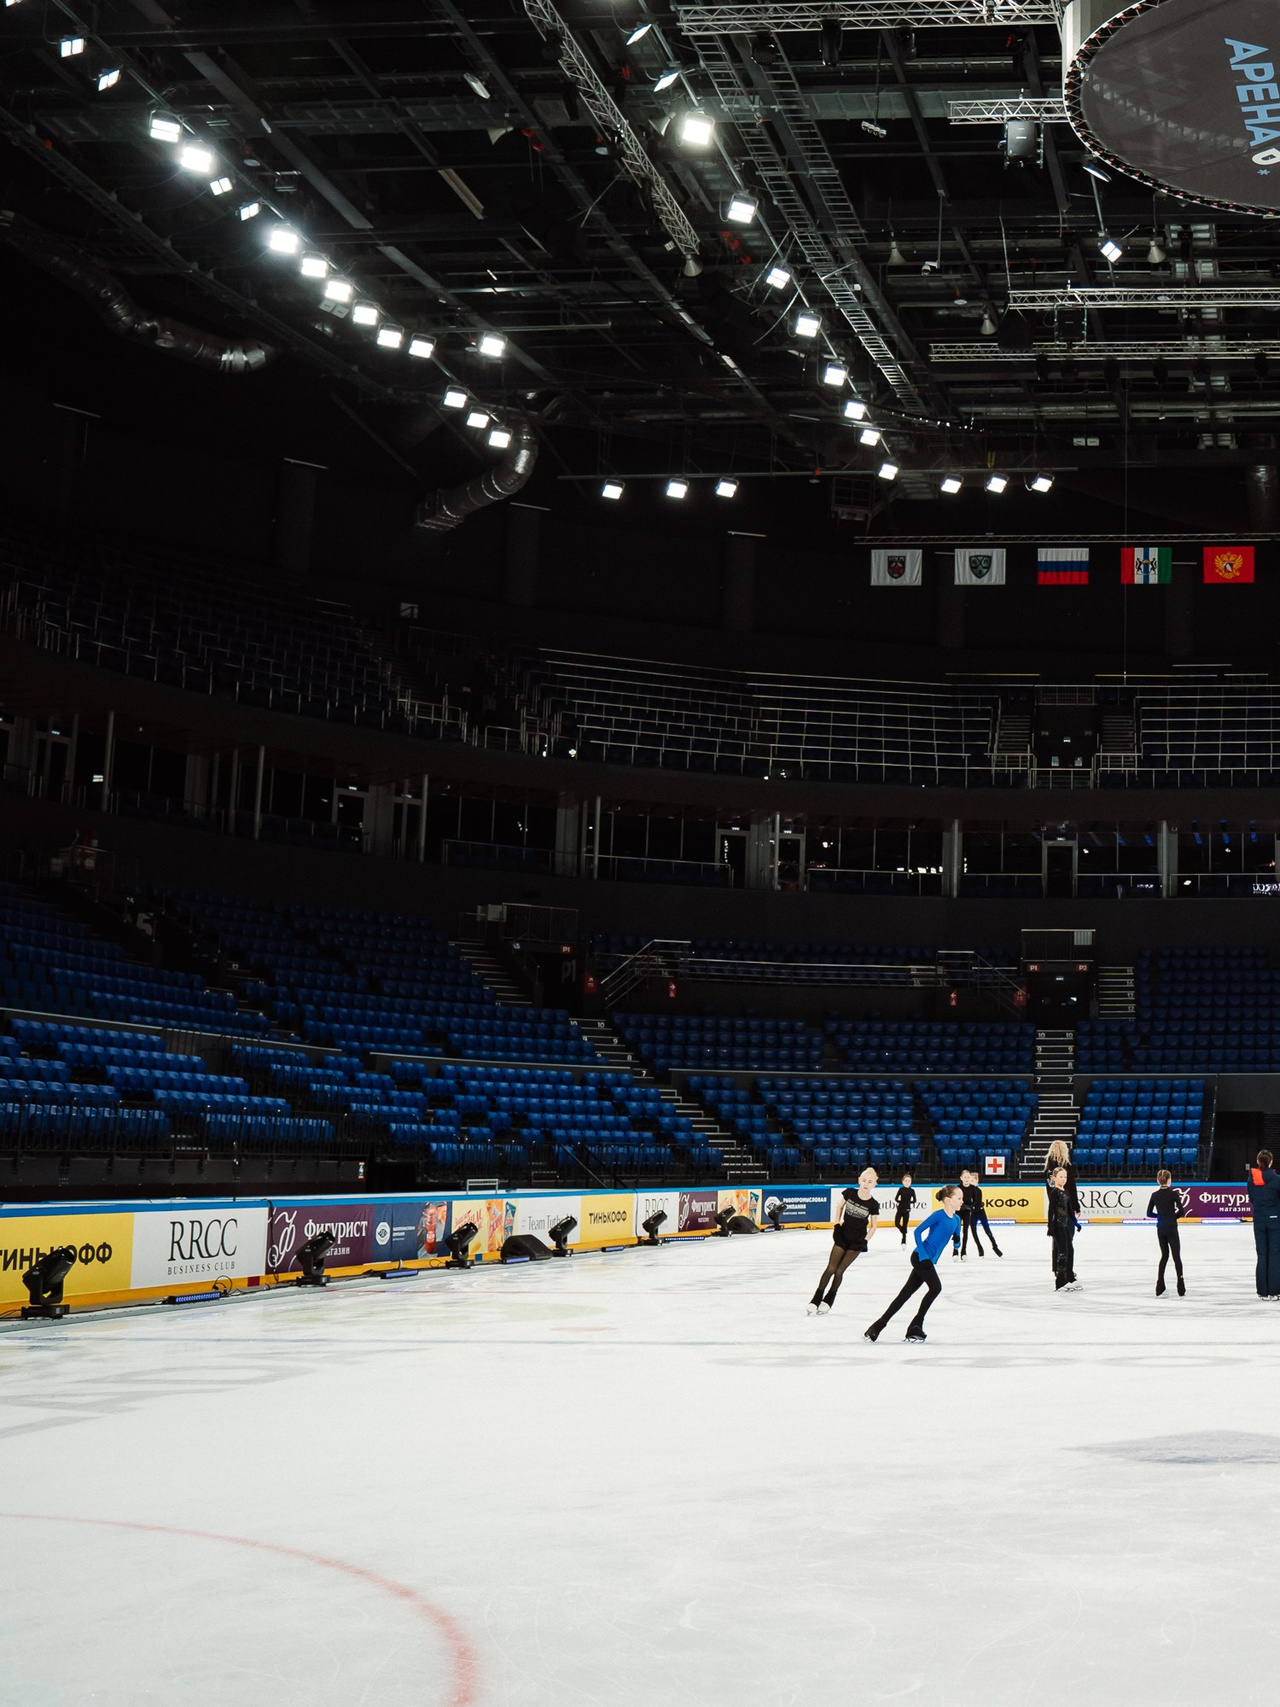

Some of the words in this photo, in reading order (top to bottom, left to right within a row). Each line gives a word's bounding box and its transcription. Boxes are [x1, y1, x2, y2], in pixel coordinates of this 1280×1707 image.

[589, 1211, 627, 1224] ТИНЬКОФФ
[168, 1219, 238, 1261] RRCC
[326, 1247, 350, 1256] агазин
[168, 1263, 211, 1275] BUSINESS
[214, 1261, 235, 1271] CLUB
